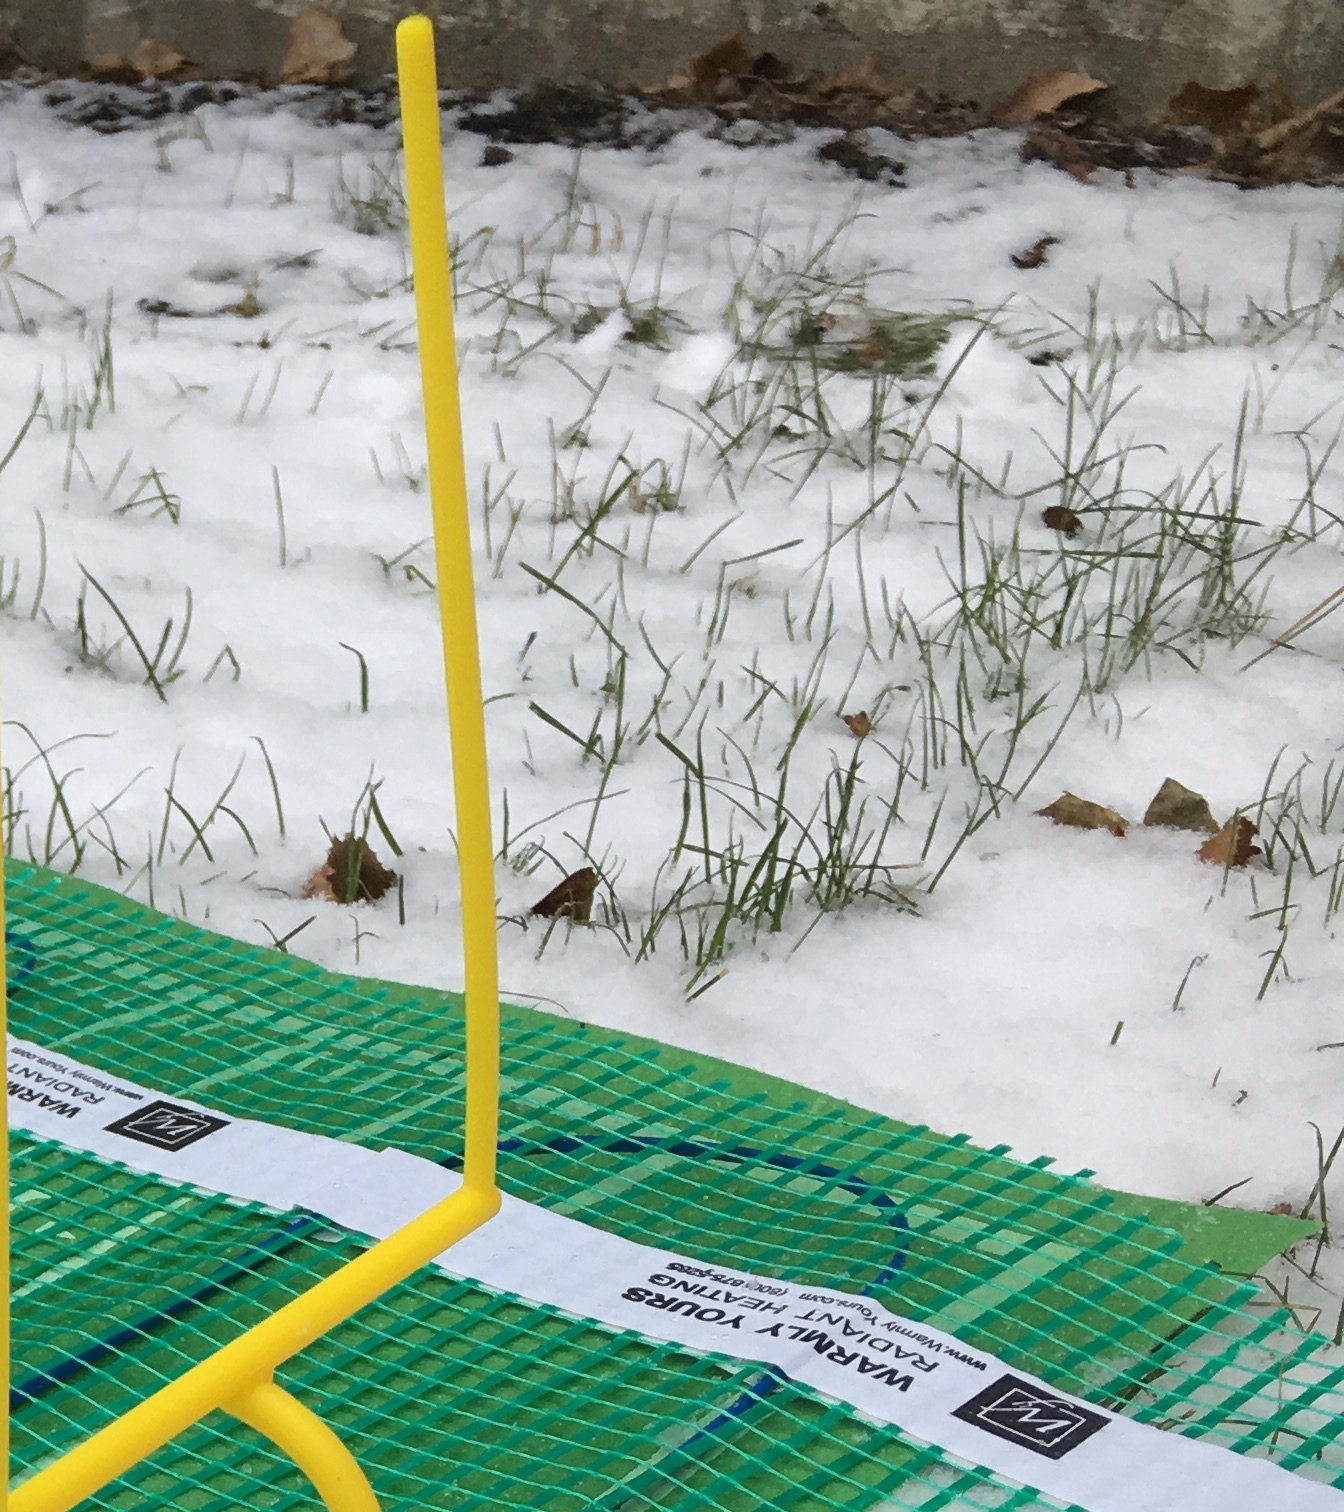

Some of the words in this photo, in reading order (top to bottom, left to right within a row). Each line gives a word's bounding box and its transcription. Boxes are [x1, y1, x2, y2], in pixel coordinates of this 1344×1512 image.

[621, 1288, 745, 1329] YOURS
[648, 1274, 788, 1314] HEATING
[755, 1323, 914, 1392] WARMLY
[795, 1309, 939, 1372] RADIANT
